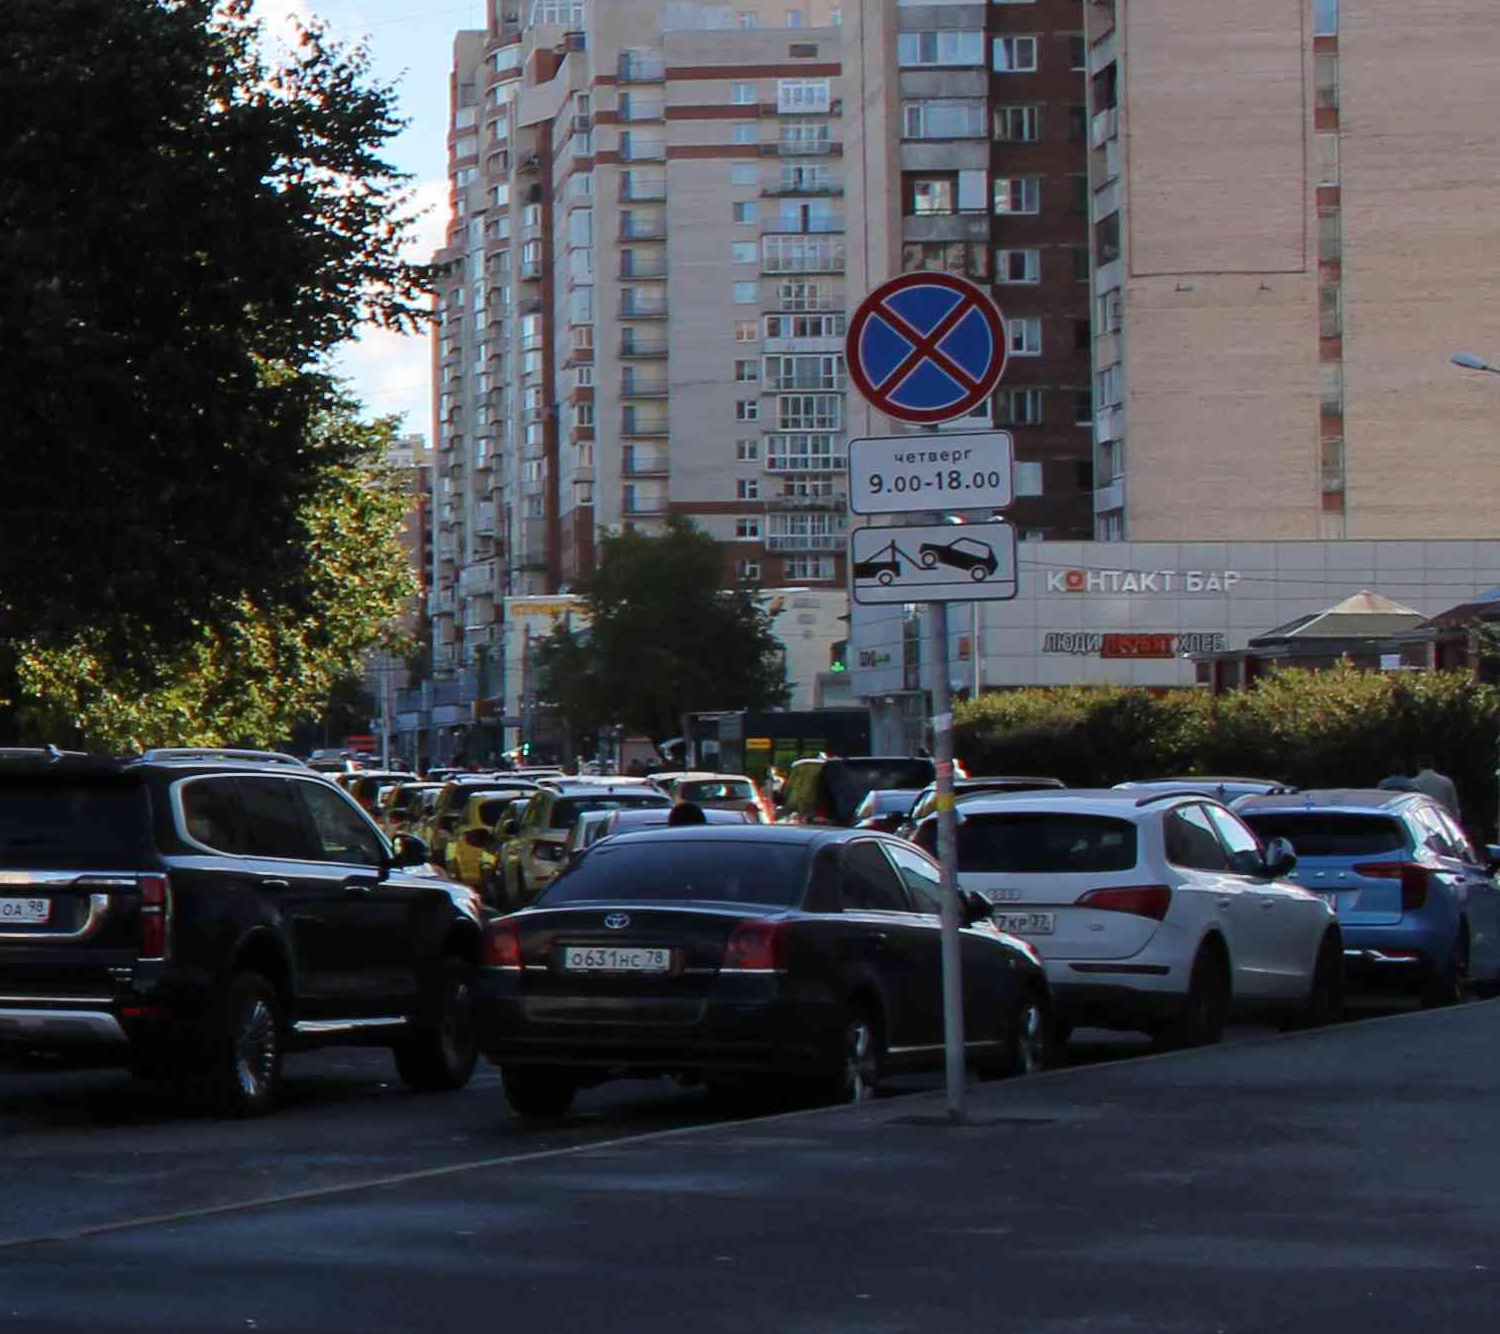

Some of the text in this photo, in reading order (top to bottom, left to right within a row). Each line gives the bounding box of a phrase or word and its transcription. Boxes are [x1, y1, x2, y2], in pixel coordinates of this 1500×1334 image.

[894, 448, 973, 465] четверг
[868, 470, 1000, 494] 9.00-18.00
[1047, 570, 1241, 592] КОНТАКТ БАР
[1044, 633, 1100, 654] ЛЮДИ
[1177, 633, 1225, 652] ХЛЕБ
